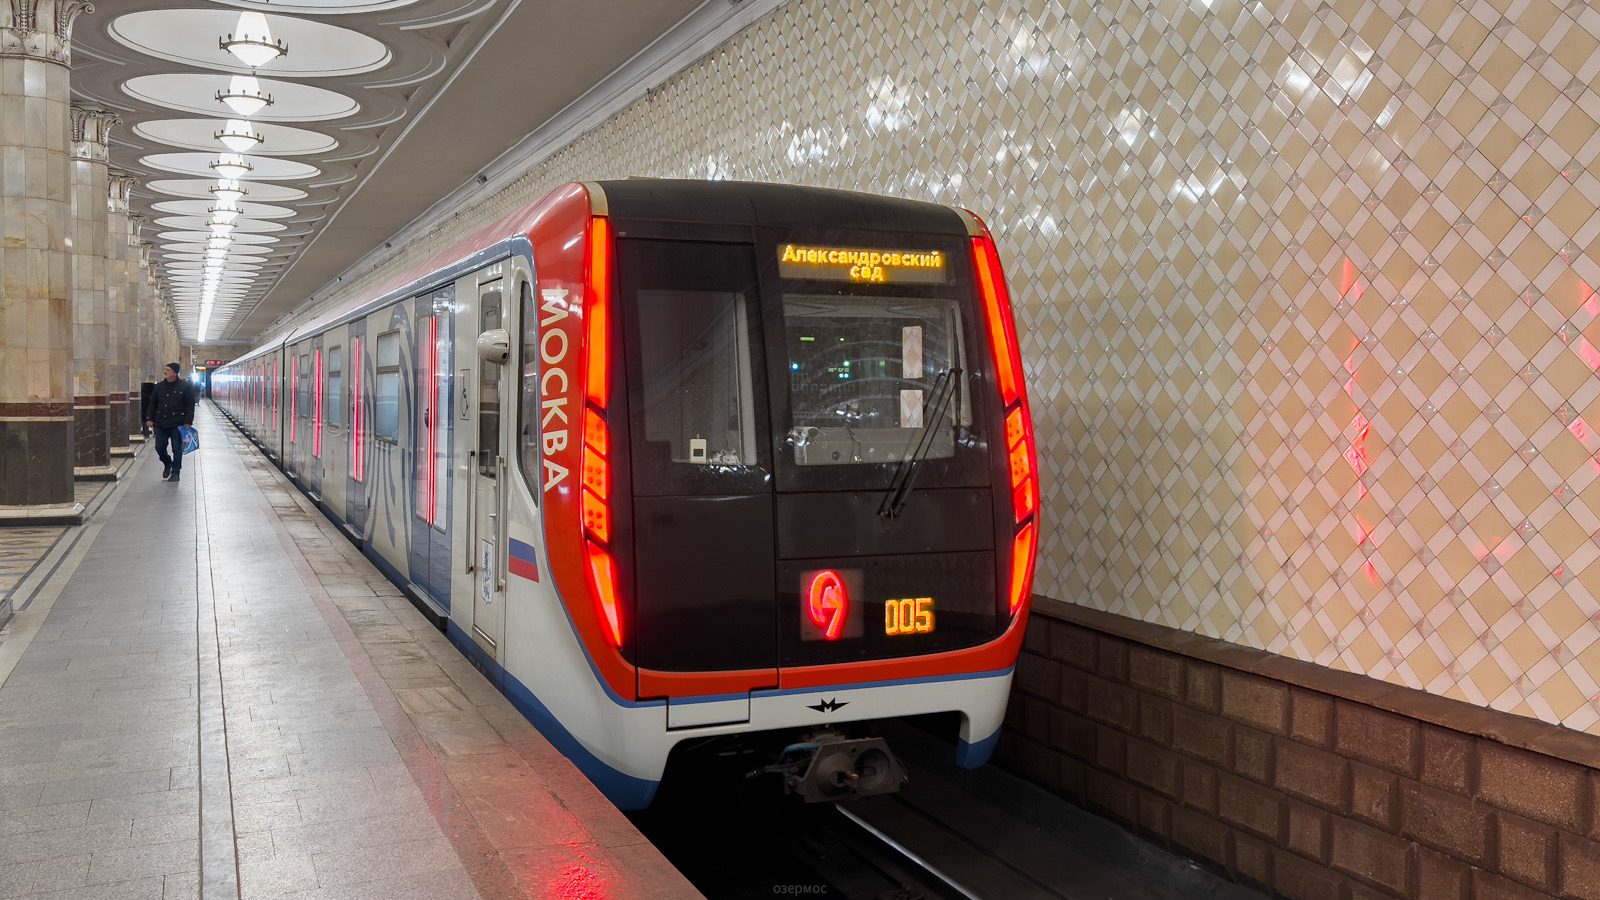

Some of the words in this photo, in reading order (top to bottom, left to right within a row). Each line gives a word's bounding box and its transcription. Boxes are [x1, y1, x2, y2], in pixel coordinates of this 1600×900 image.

[782, 245, 941, 267] Александровский
[850, 266, 884, 281] сад
[540, 288, 569, 493] МОСКВА
[884, 597, 934, 635] 005
